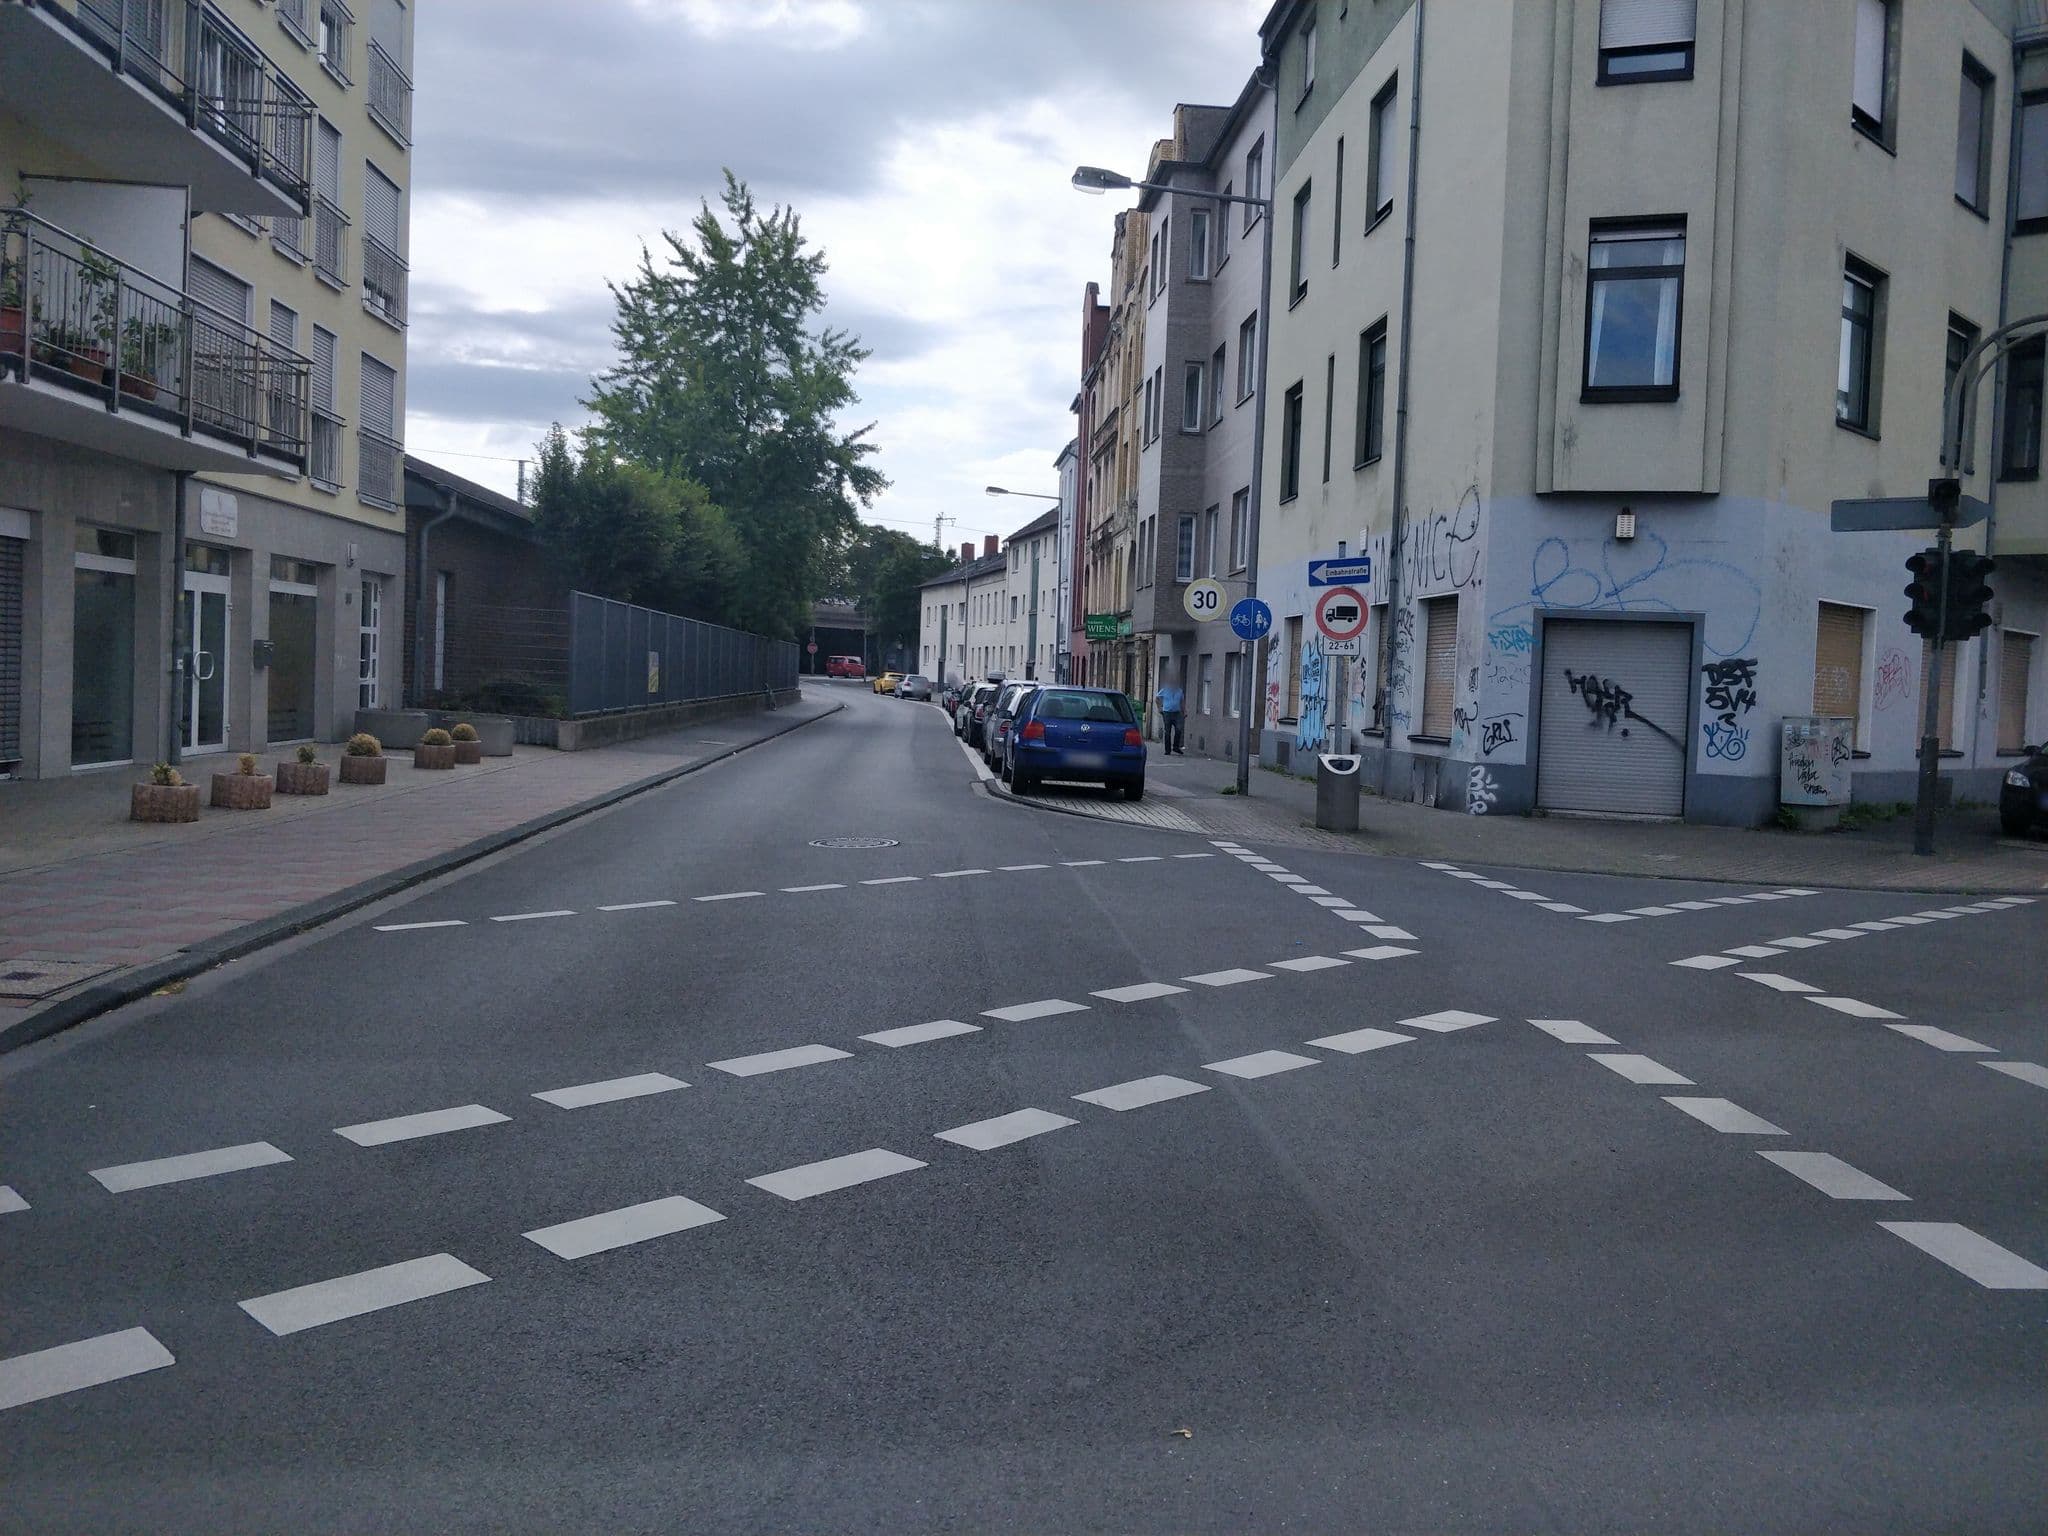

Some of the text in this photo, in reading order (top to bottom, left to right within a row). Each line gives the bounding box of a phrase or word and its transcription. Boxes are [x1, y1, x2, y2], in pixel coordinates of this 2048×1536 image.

[1325, 567, 1368, 577] Einbahnstraße
[1193, 590, 1218, 610] 30
[1087, 625, 1117, 633] WIENS
